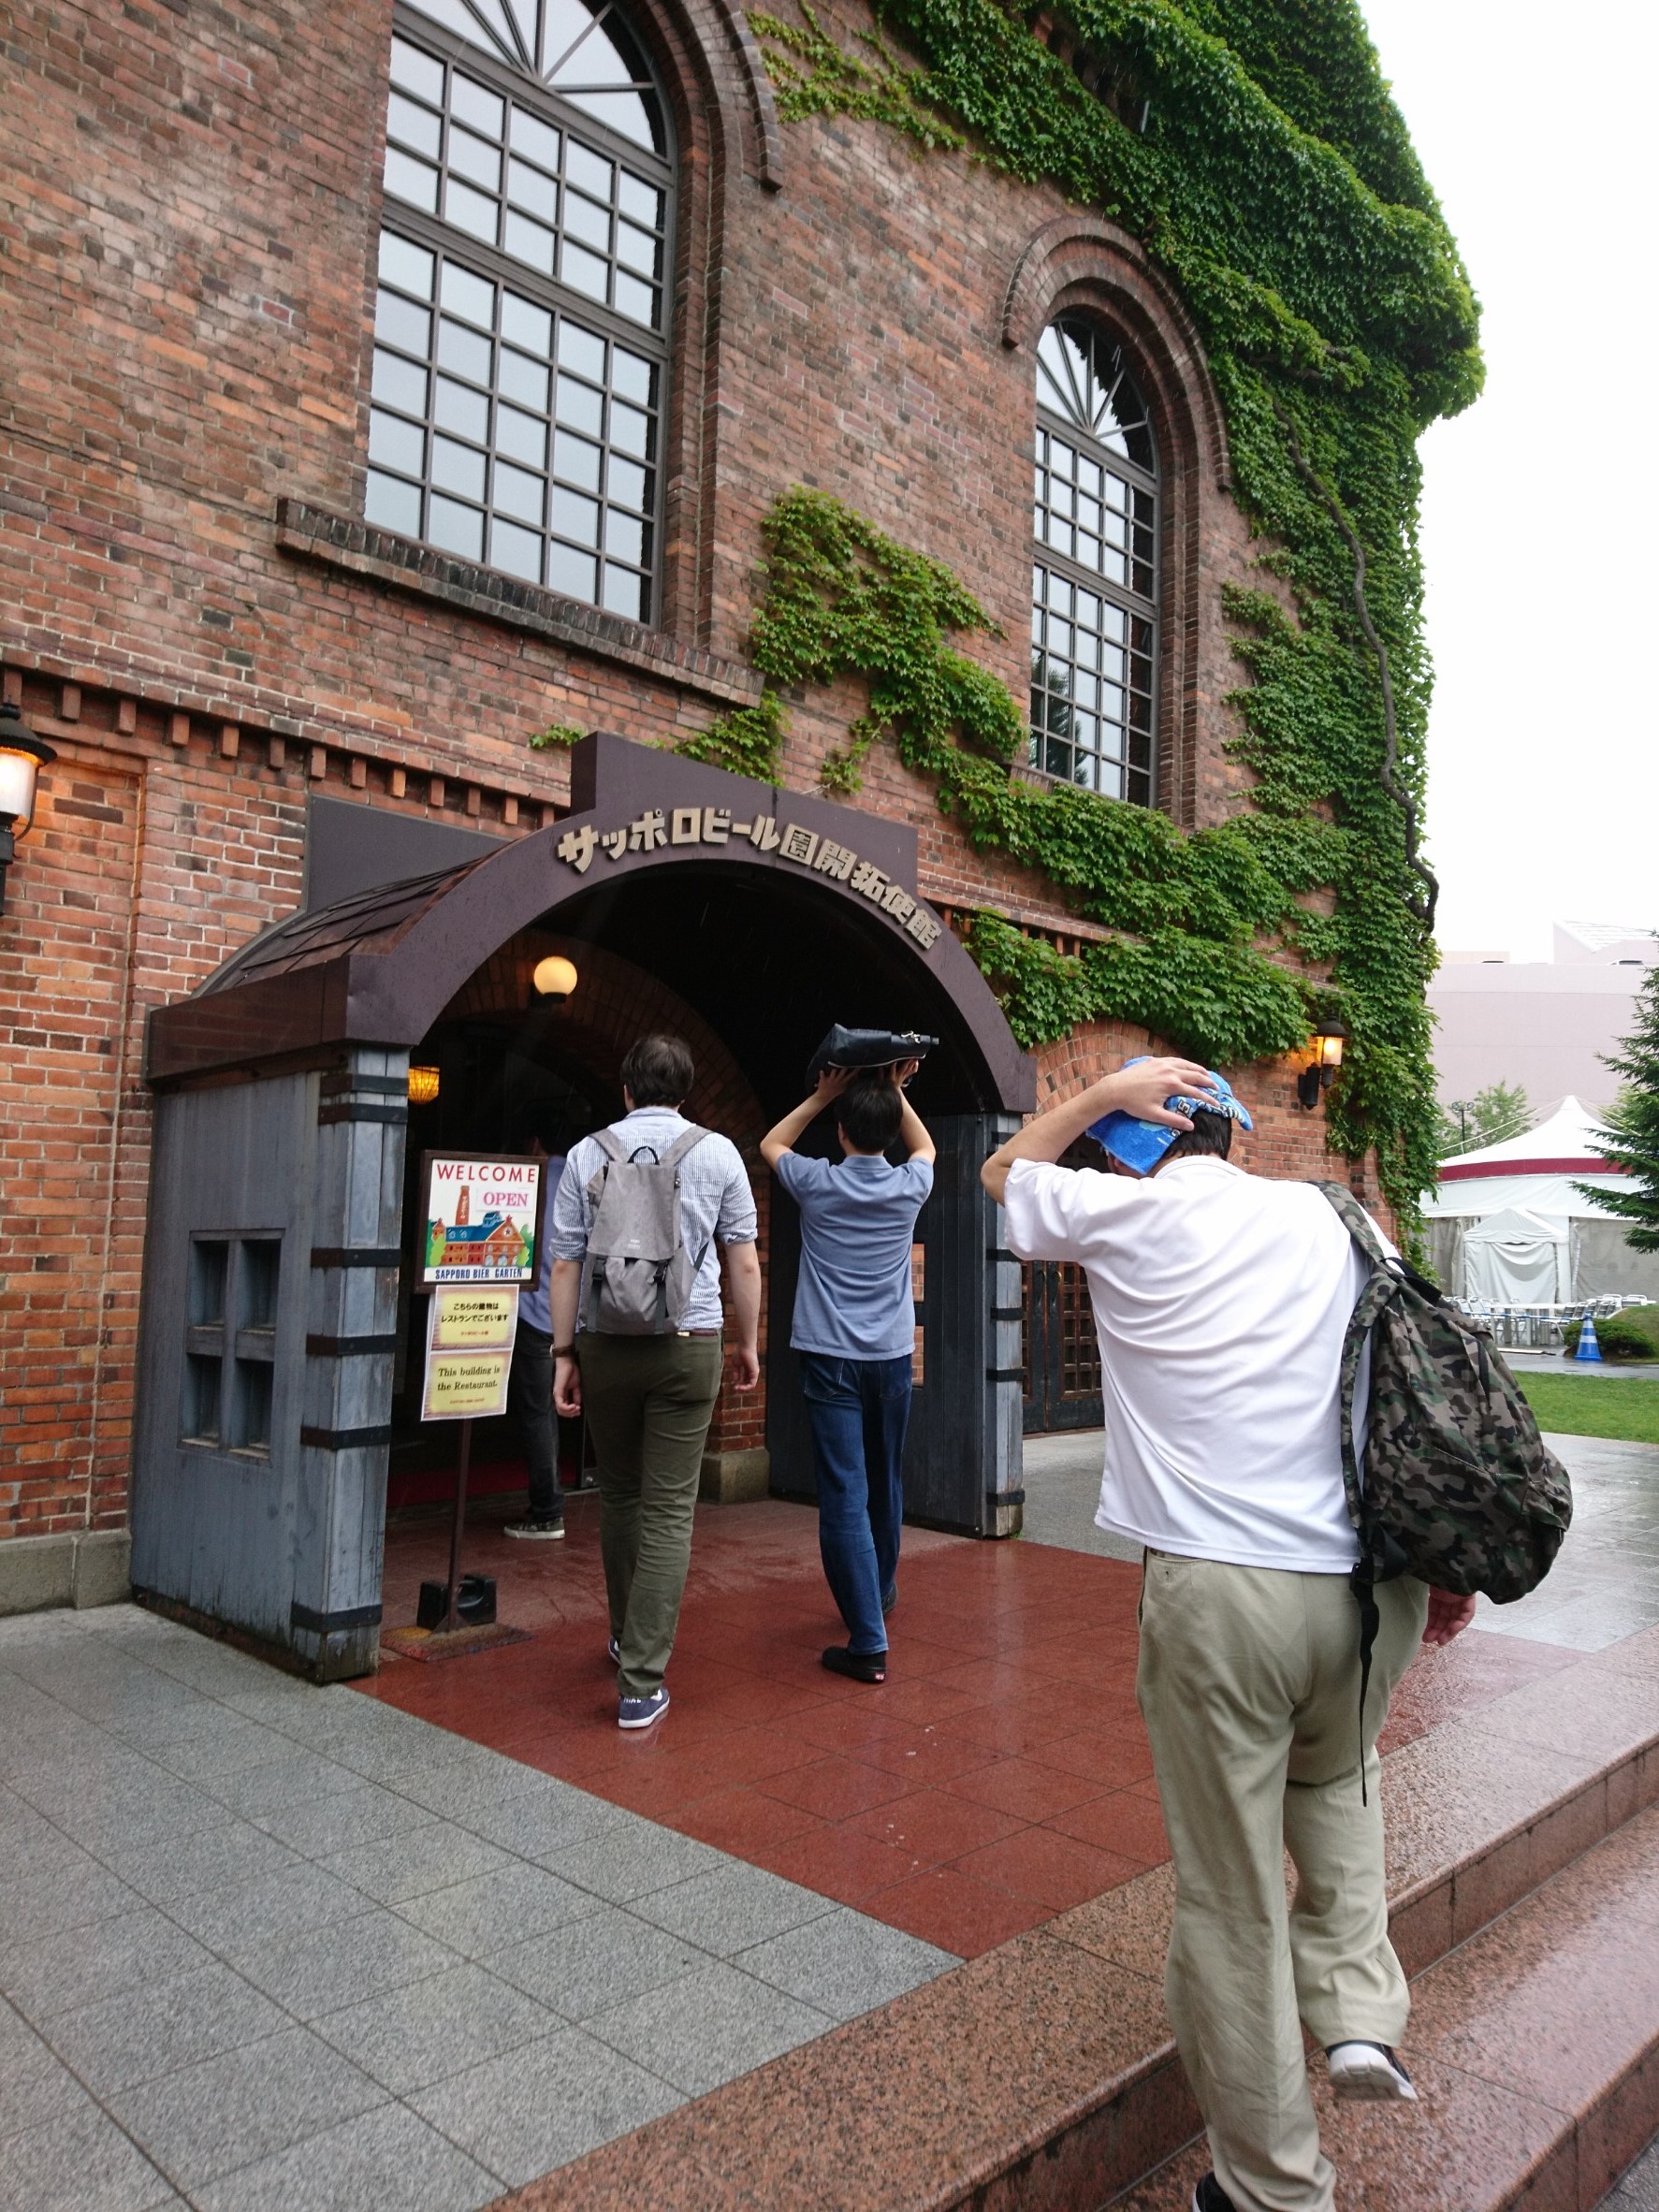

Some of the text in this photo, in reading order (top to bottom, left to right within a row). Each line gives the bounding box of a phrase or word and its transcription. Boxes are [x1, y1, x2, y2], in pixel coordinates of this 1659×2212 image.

[558, 808, 942, 950] サッポロビール園開拓使館
[437, 1164, 535, 1183] WELCOME
[483, 1192, 529, 1206] OPEN
[435, 1267, 523, 1280] SAPPORO BIER GARTEN
[438, 1365, 501, 1377] This building is
[437, 1382, 451, 1390] the
